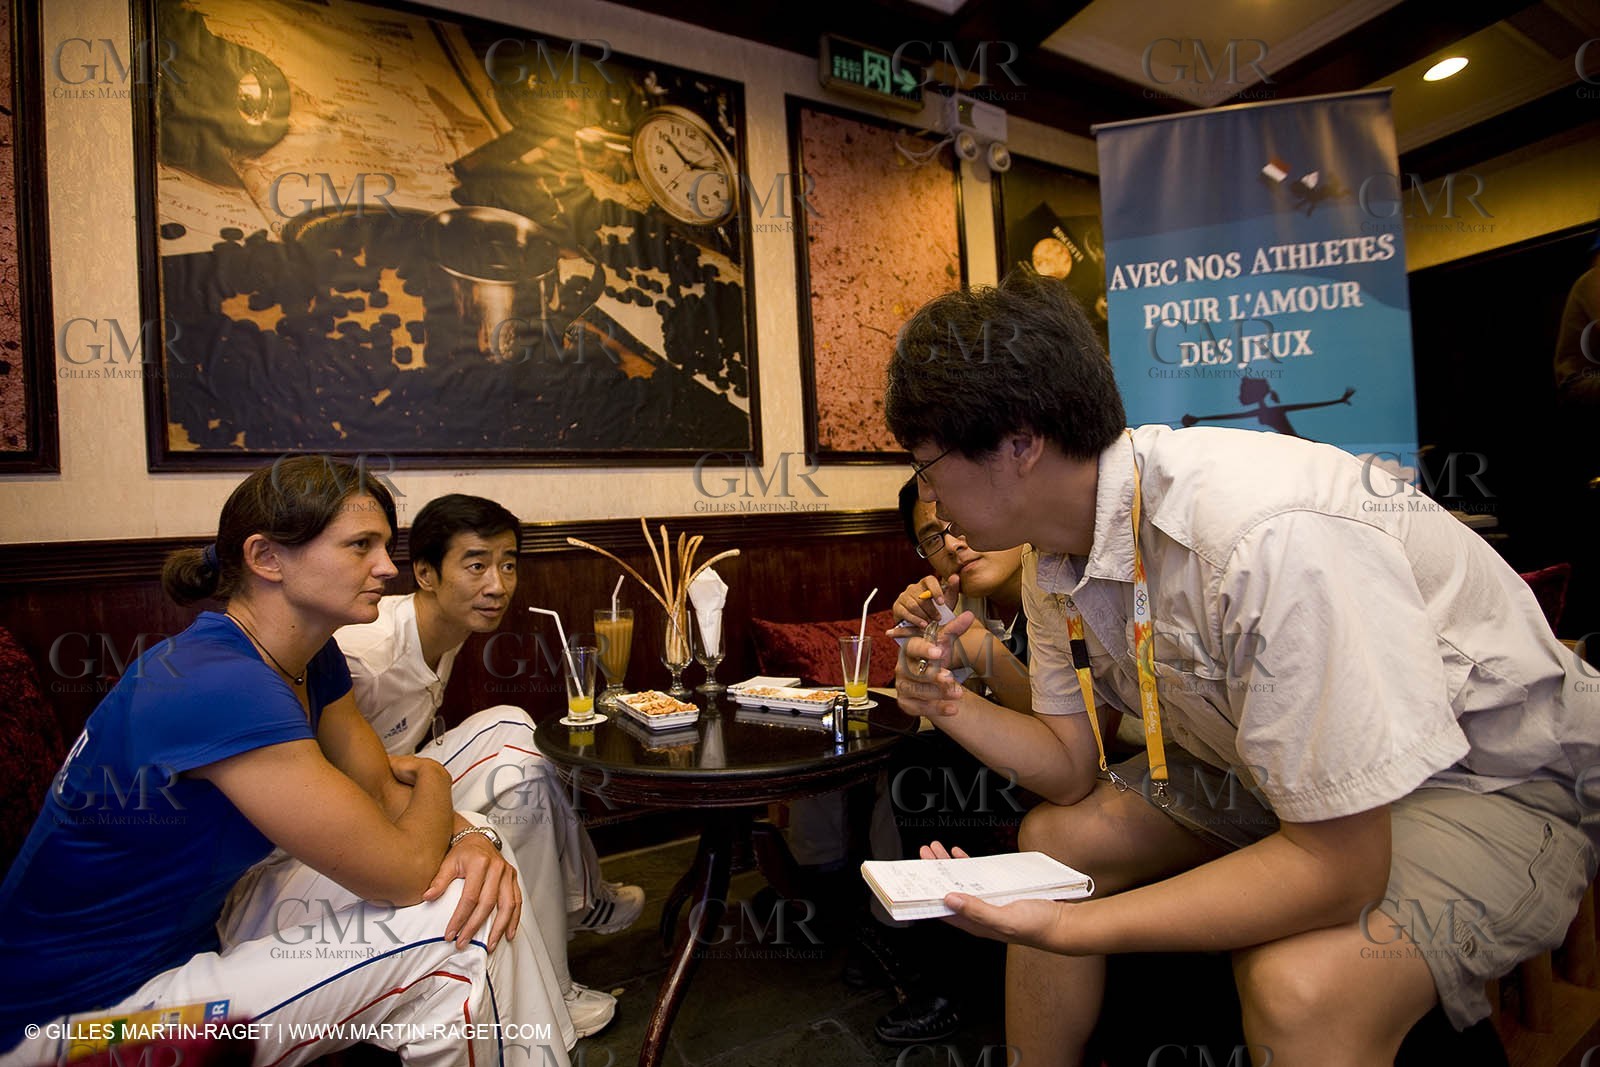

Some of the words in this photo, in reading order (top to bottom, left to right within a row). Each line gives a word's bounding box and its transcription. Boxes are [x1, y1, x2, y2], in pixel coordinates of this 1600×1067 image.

[1109, 259, 1180, 292] AVEC
[1185, 252, 1241, 283] NOS
[1249, 233, 1396, 276] ATHLETES
[1143, 297, 1221, 330] POUR
[1229, 281, 1364, 321] L'AMOUR
[1179, 338, 1234, 368] DES
[1237, 329, 1314, 369] JEUX
